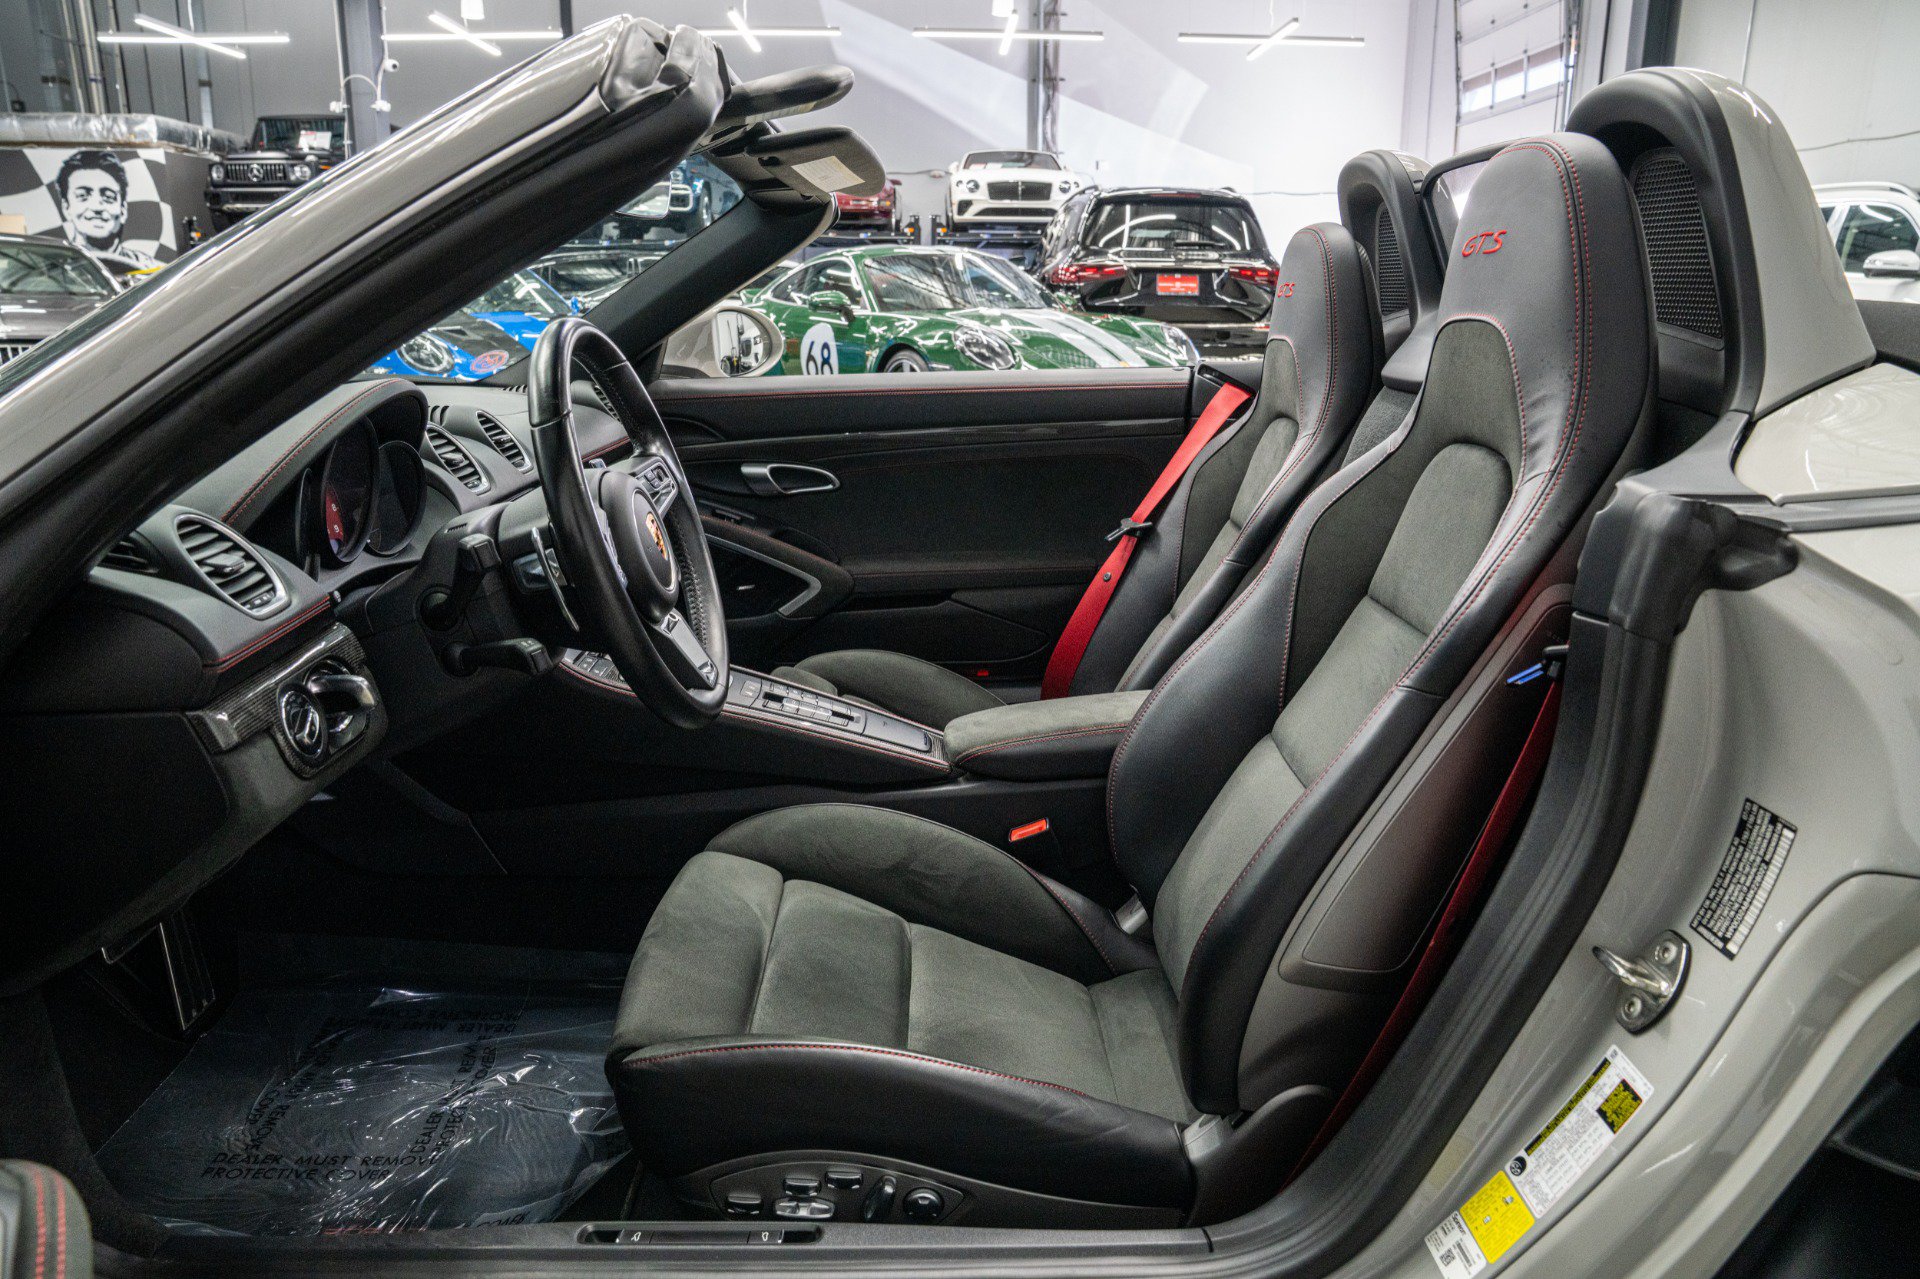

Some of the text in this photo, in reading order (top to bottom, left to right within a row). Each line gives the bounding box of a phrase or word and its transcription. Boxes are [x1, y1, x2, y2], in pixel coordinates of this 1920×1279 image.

[1462, 229, 1508, 257] GTS
[806, 340, 834, 375] 68
[211, 1152, 284, 1165] DEALER
[294, 1154, 353, 1166] MUST
[200, 1166, 323, 1180] PROTECTIVE
